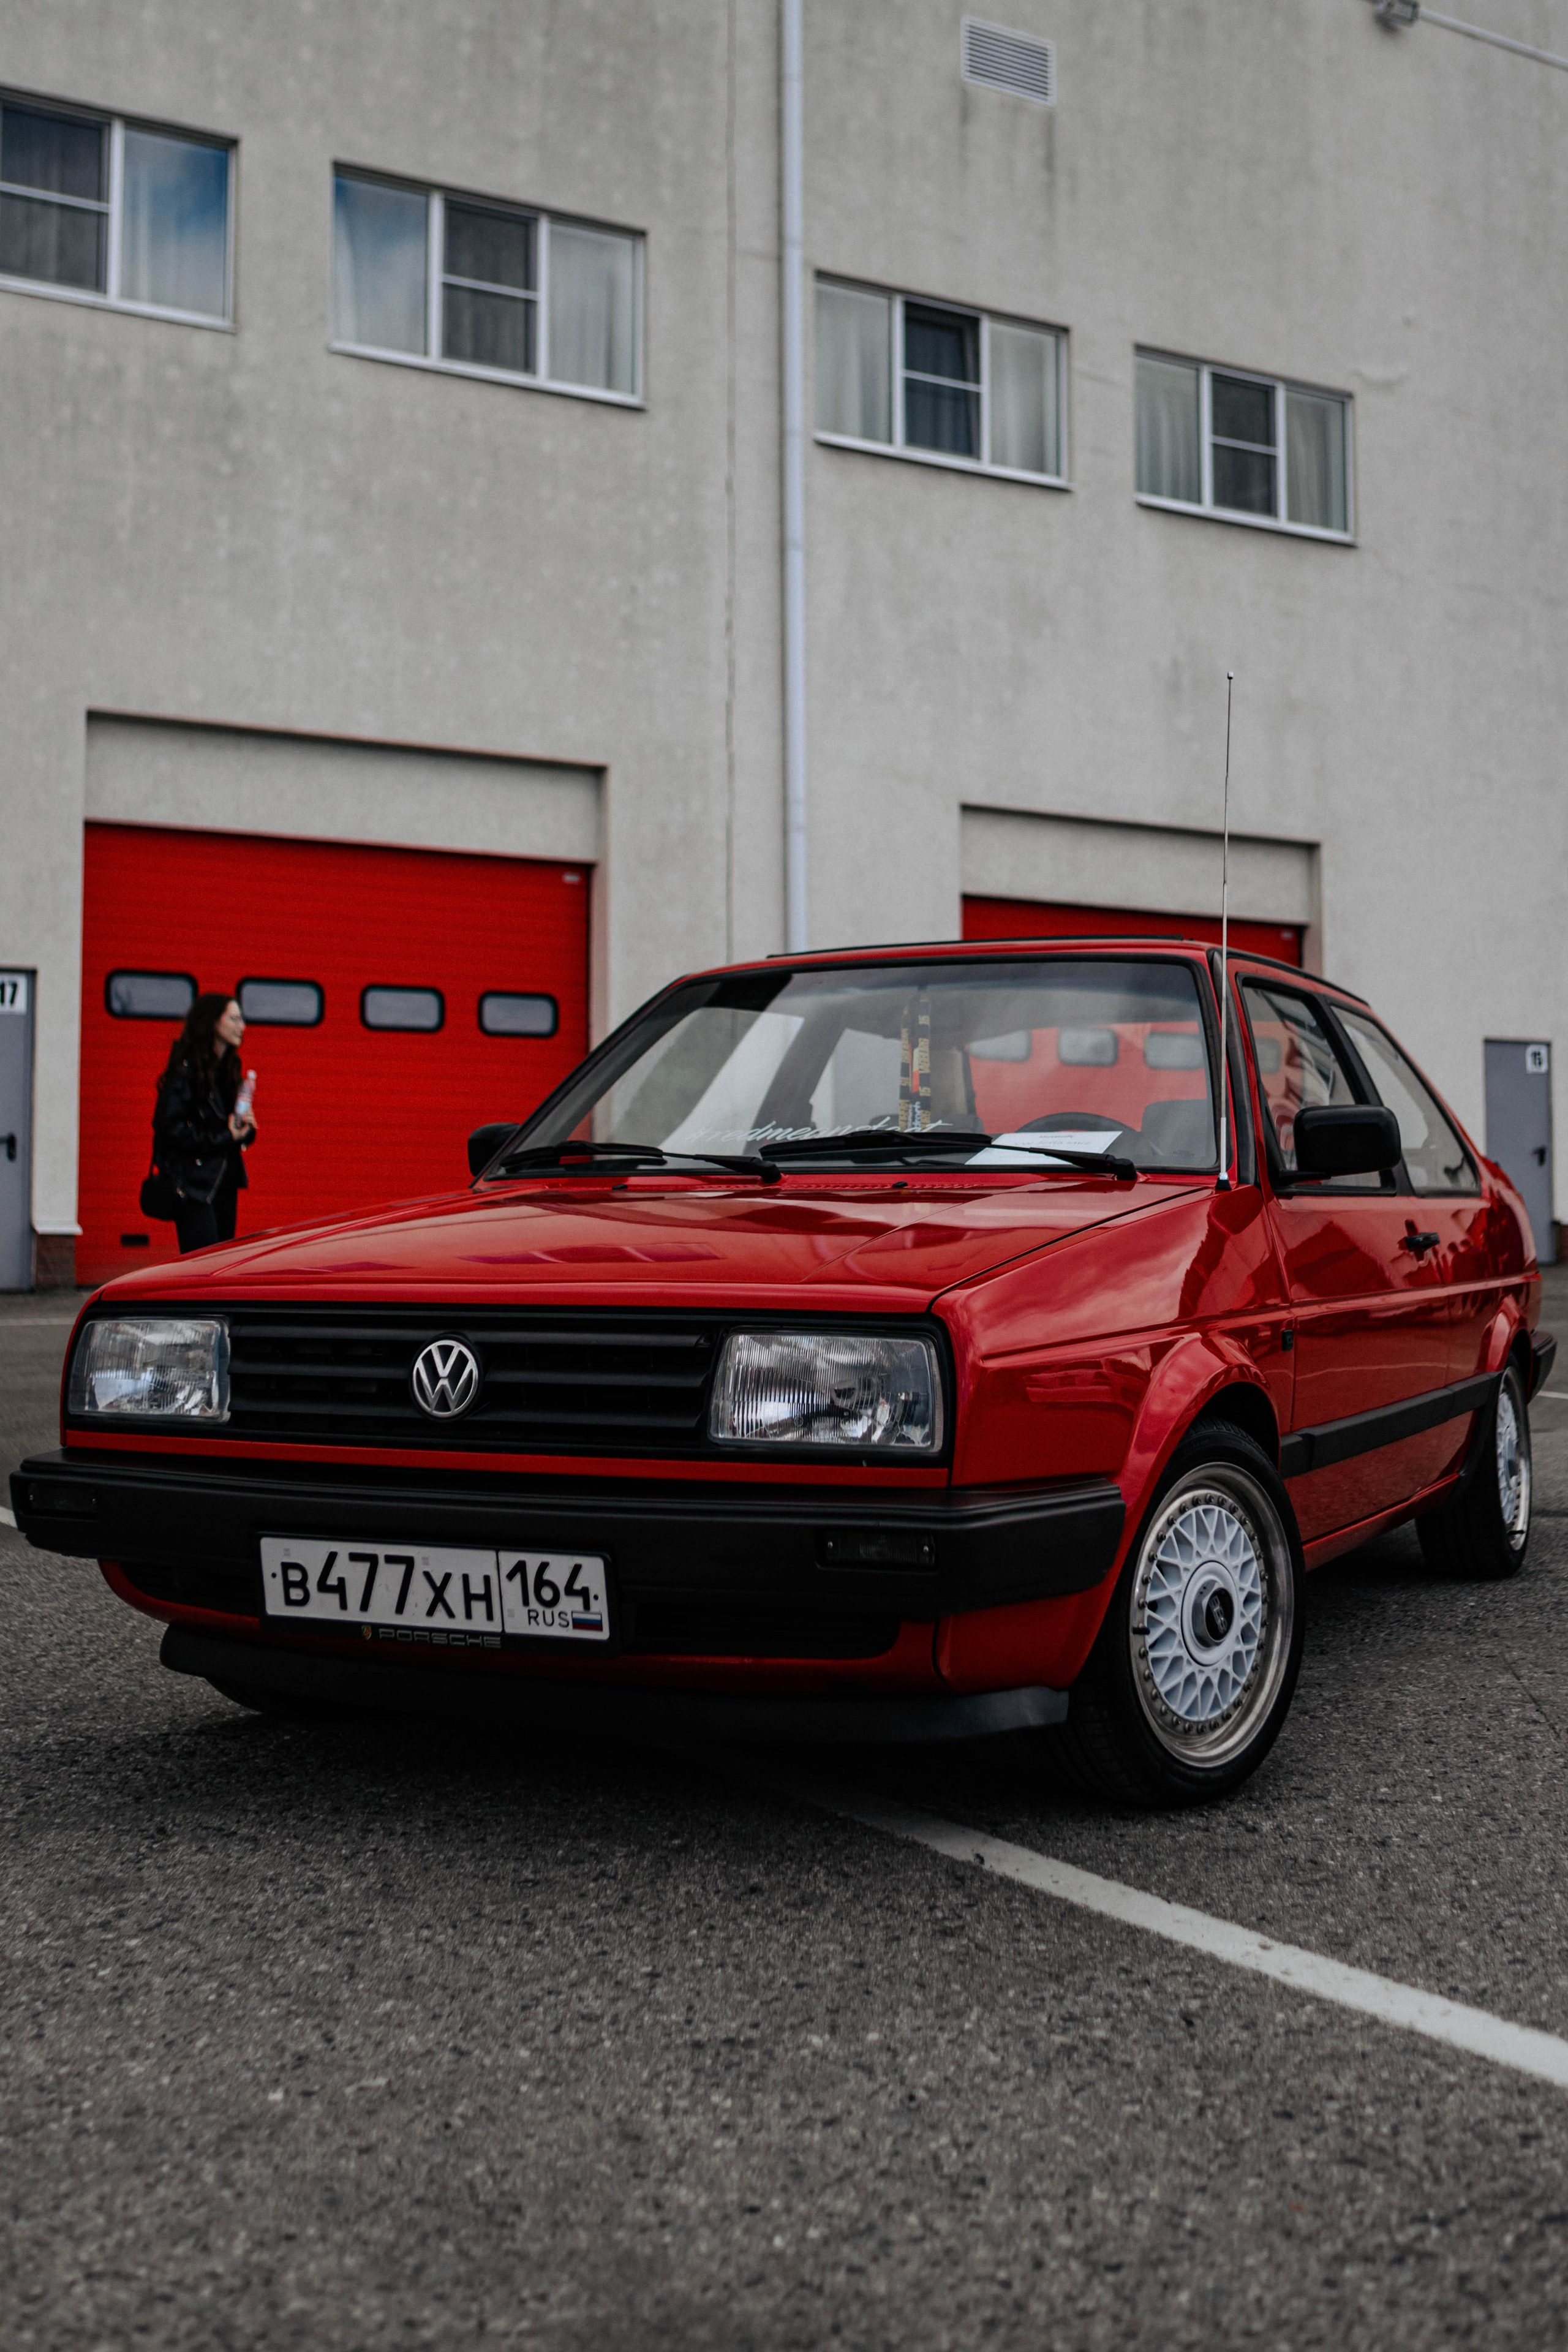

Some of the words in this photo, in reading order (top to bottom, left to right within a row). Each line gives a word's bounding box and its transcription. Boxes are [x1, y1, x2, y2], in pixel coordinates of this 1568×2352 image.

[0, 981, 17, 1005] 17
[414, 1340, 478, 1417] VW
[505, 1559, 590, 1611] 164
[527, 1608, 570, 1628] RUS
[379, 1628, 502, 1648] PORSCHE
